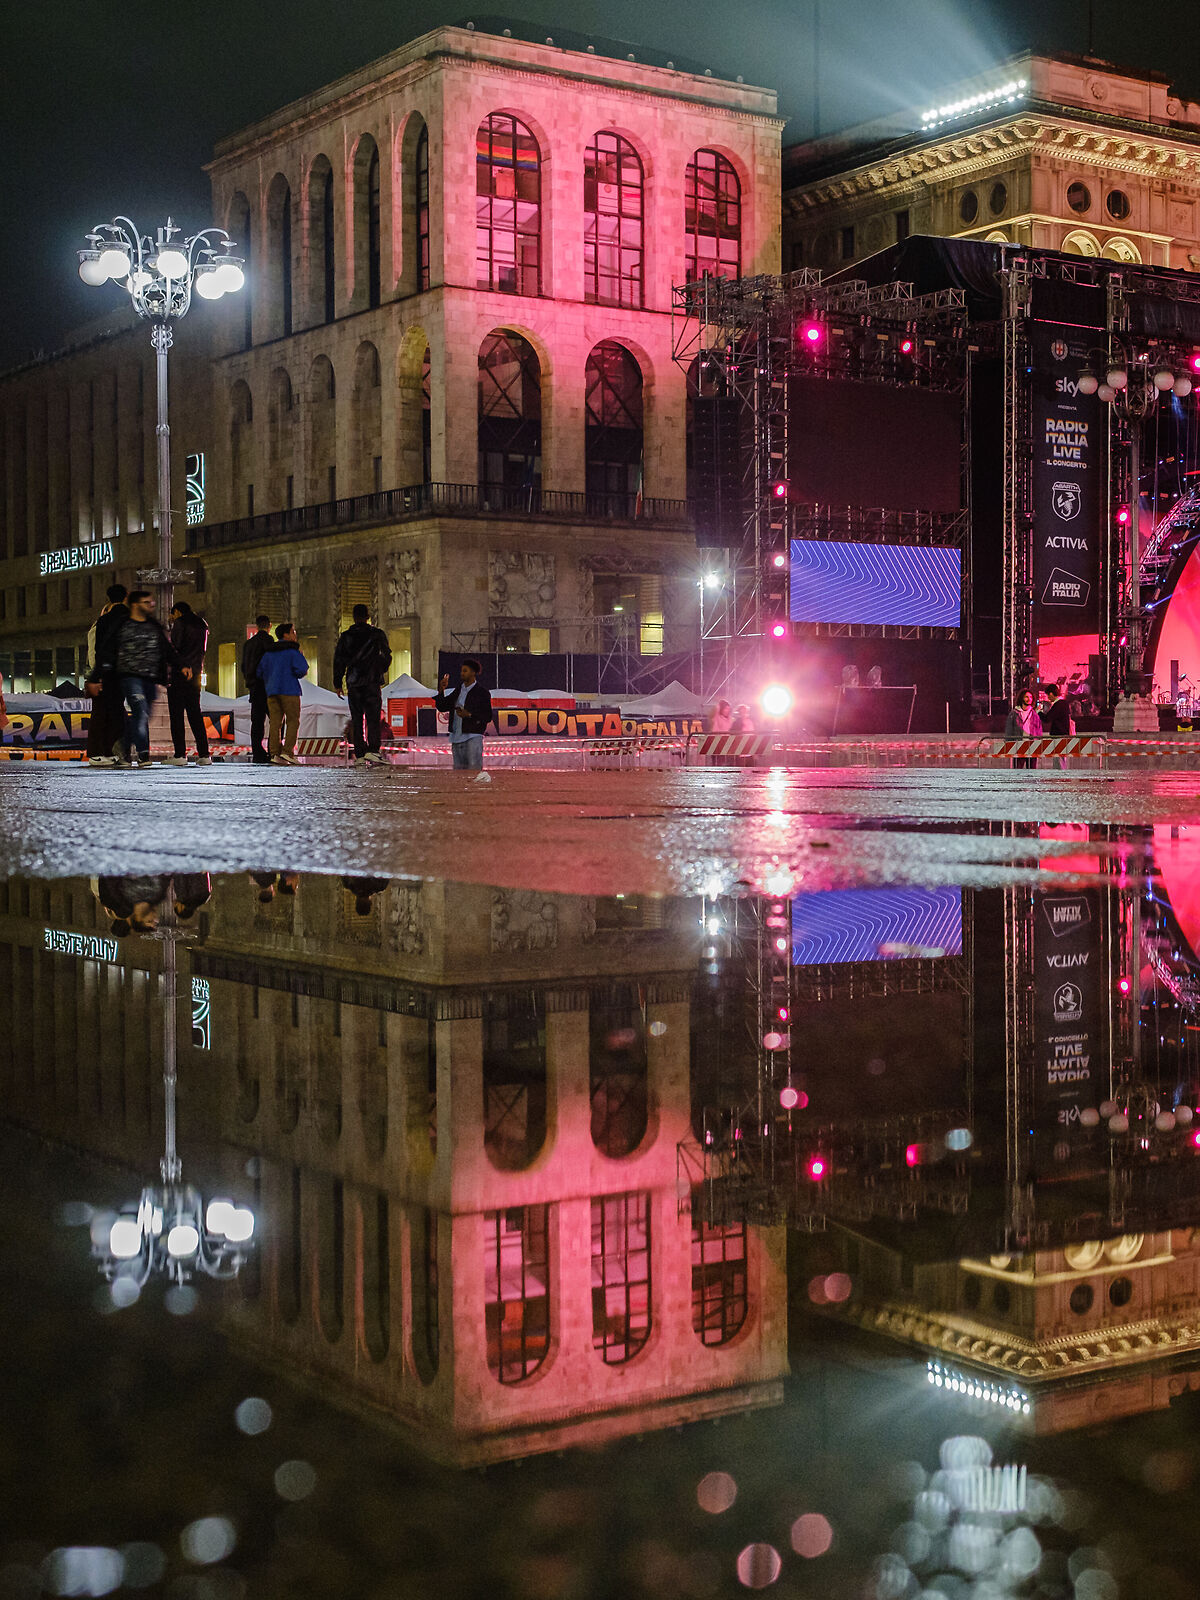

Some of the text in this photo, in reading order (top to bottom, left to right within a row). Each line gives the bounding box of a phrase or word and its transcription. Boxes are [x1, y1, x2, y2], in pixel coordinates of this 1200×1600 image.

[1055, 377, 1079, 397] sky
[1045, 418, 1088, 433] RADIO
[1045, 432, 1088, 447] ITALIA
[1053, 445, 1081, 459] LIVE
[1053, 460, 1087, 469] CONCERTO
[1045, 536, 1088, 551] ACTIVIA
[1052, 582, 1080, 590] RADIO
[1052, 590, 1080, 598] ITALIA
